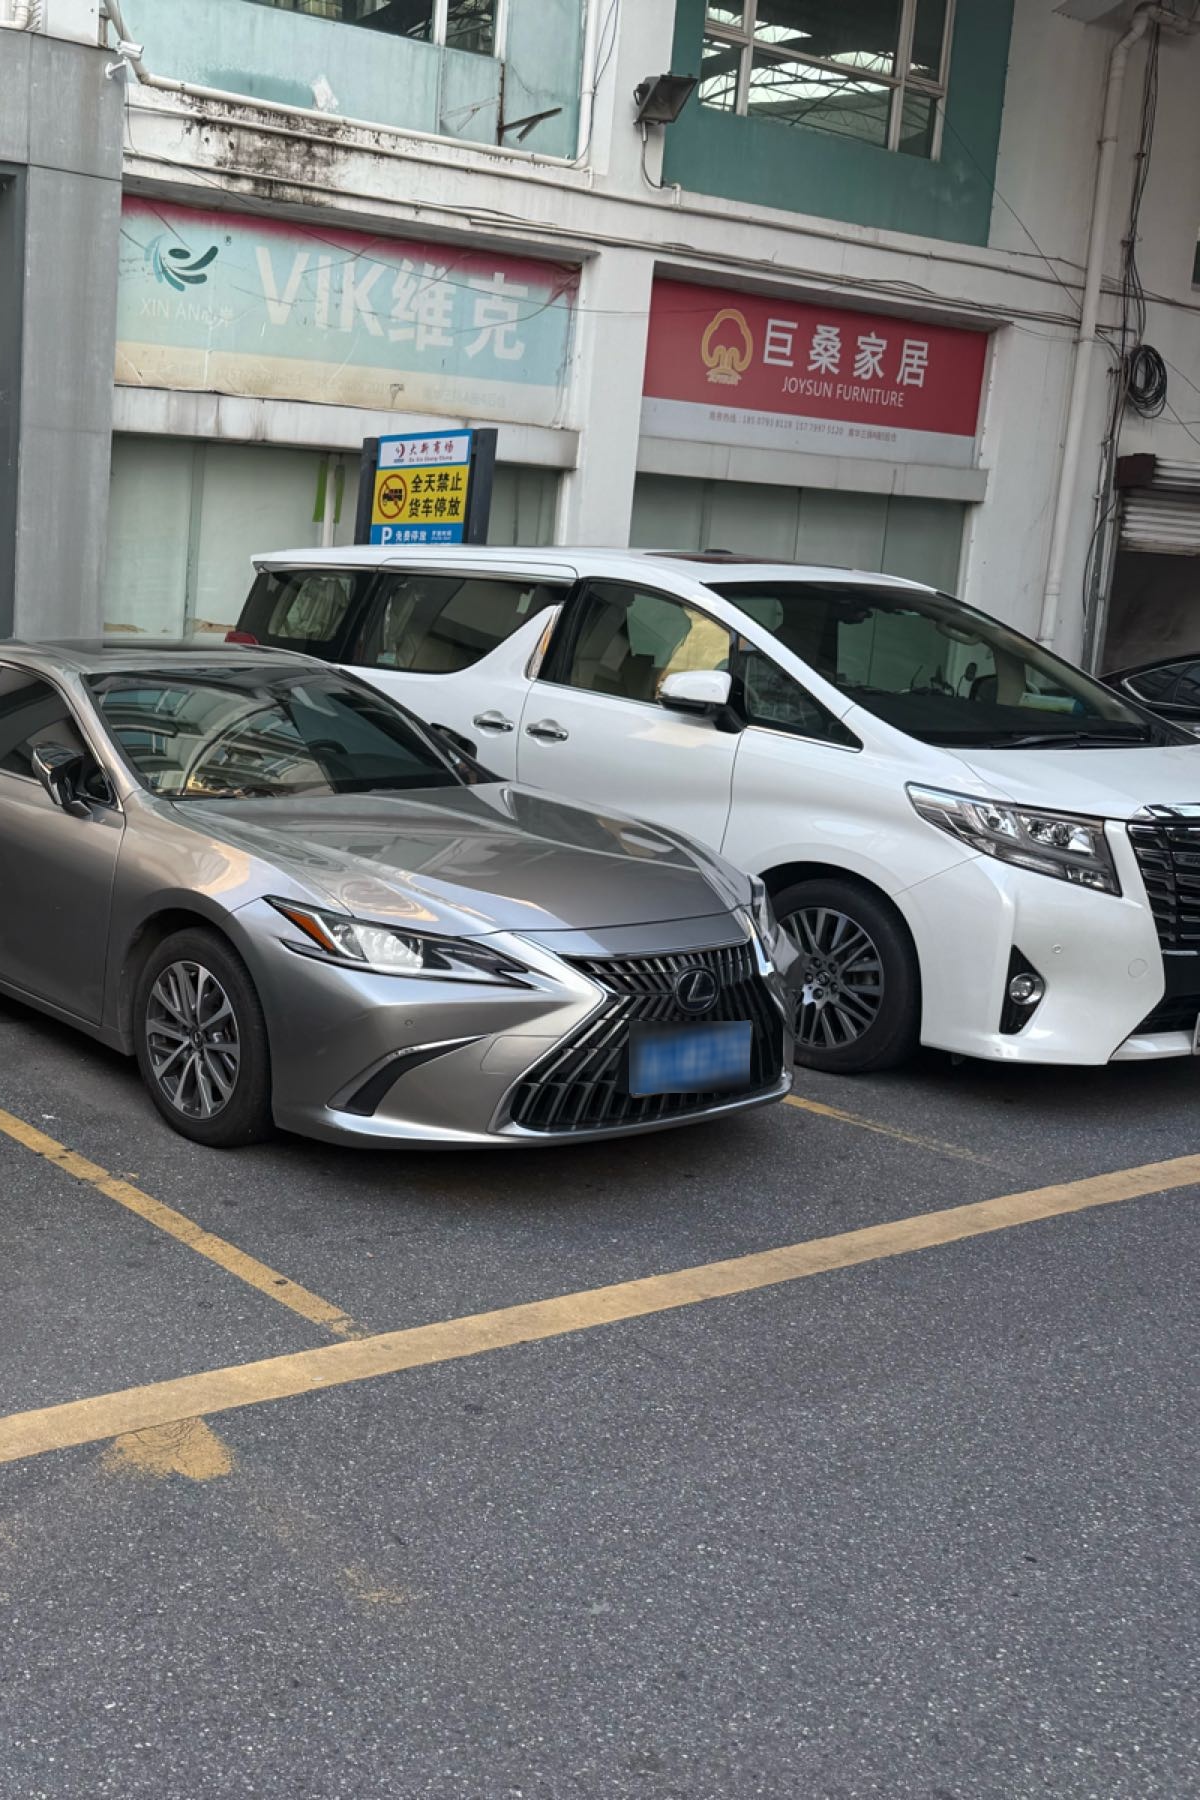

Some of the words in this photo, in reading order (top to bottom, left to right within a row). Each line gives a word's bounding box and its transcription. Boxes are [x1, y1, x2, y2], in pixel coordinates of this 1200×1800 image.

[140, 298, 169, 318] XIN
[763, 318, 929, 388] 巨桑家居
[782, 376, 834, 398] JOYSUN
[835, 383, 905, 408] FURNITURE
[411, 471, 463, 493] 全天禁止
[408, 496, 462, 518] 货车停放
